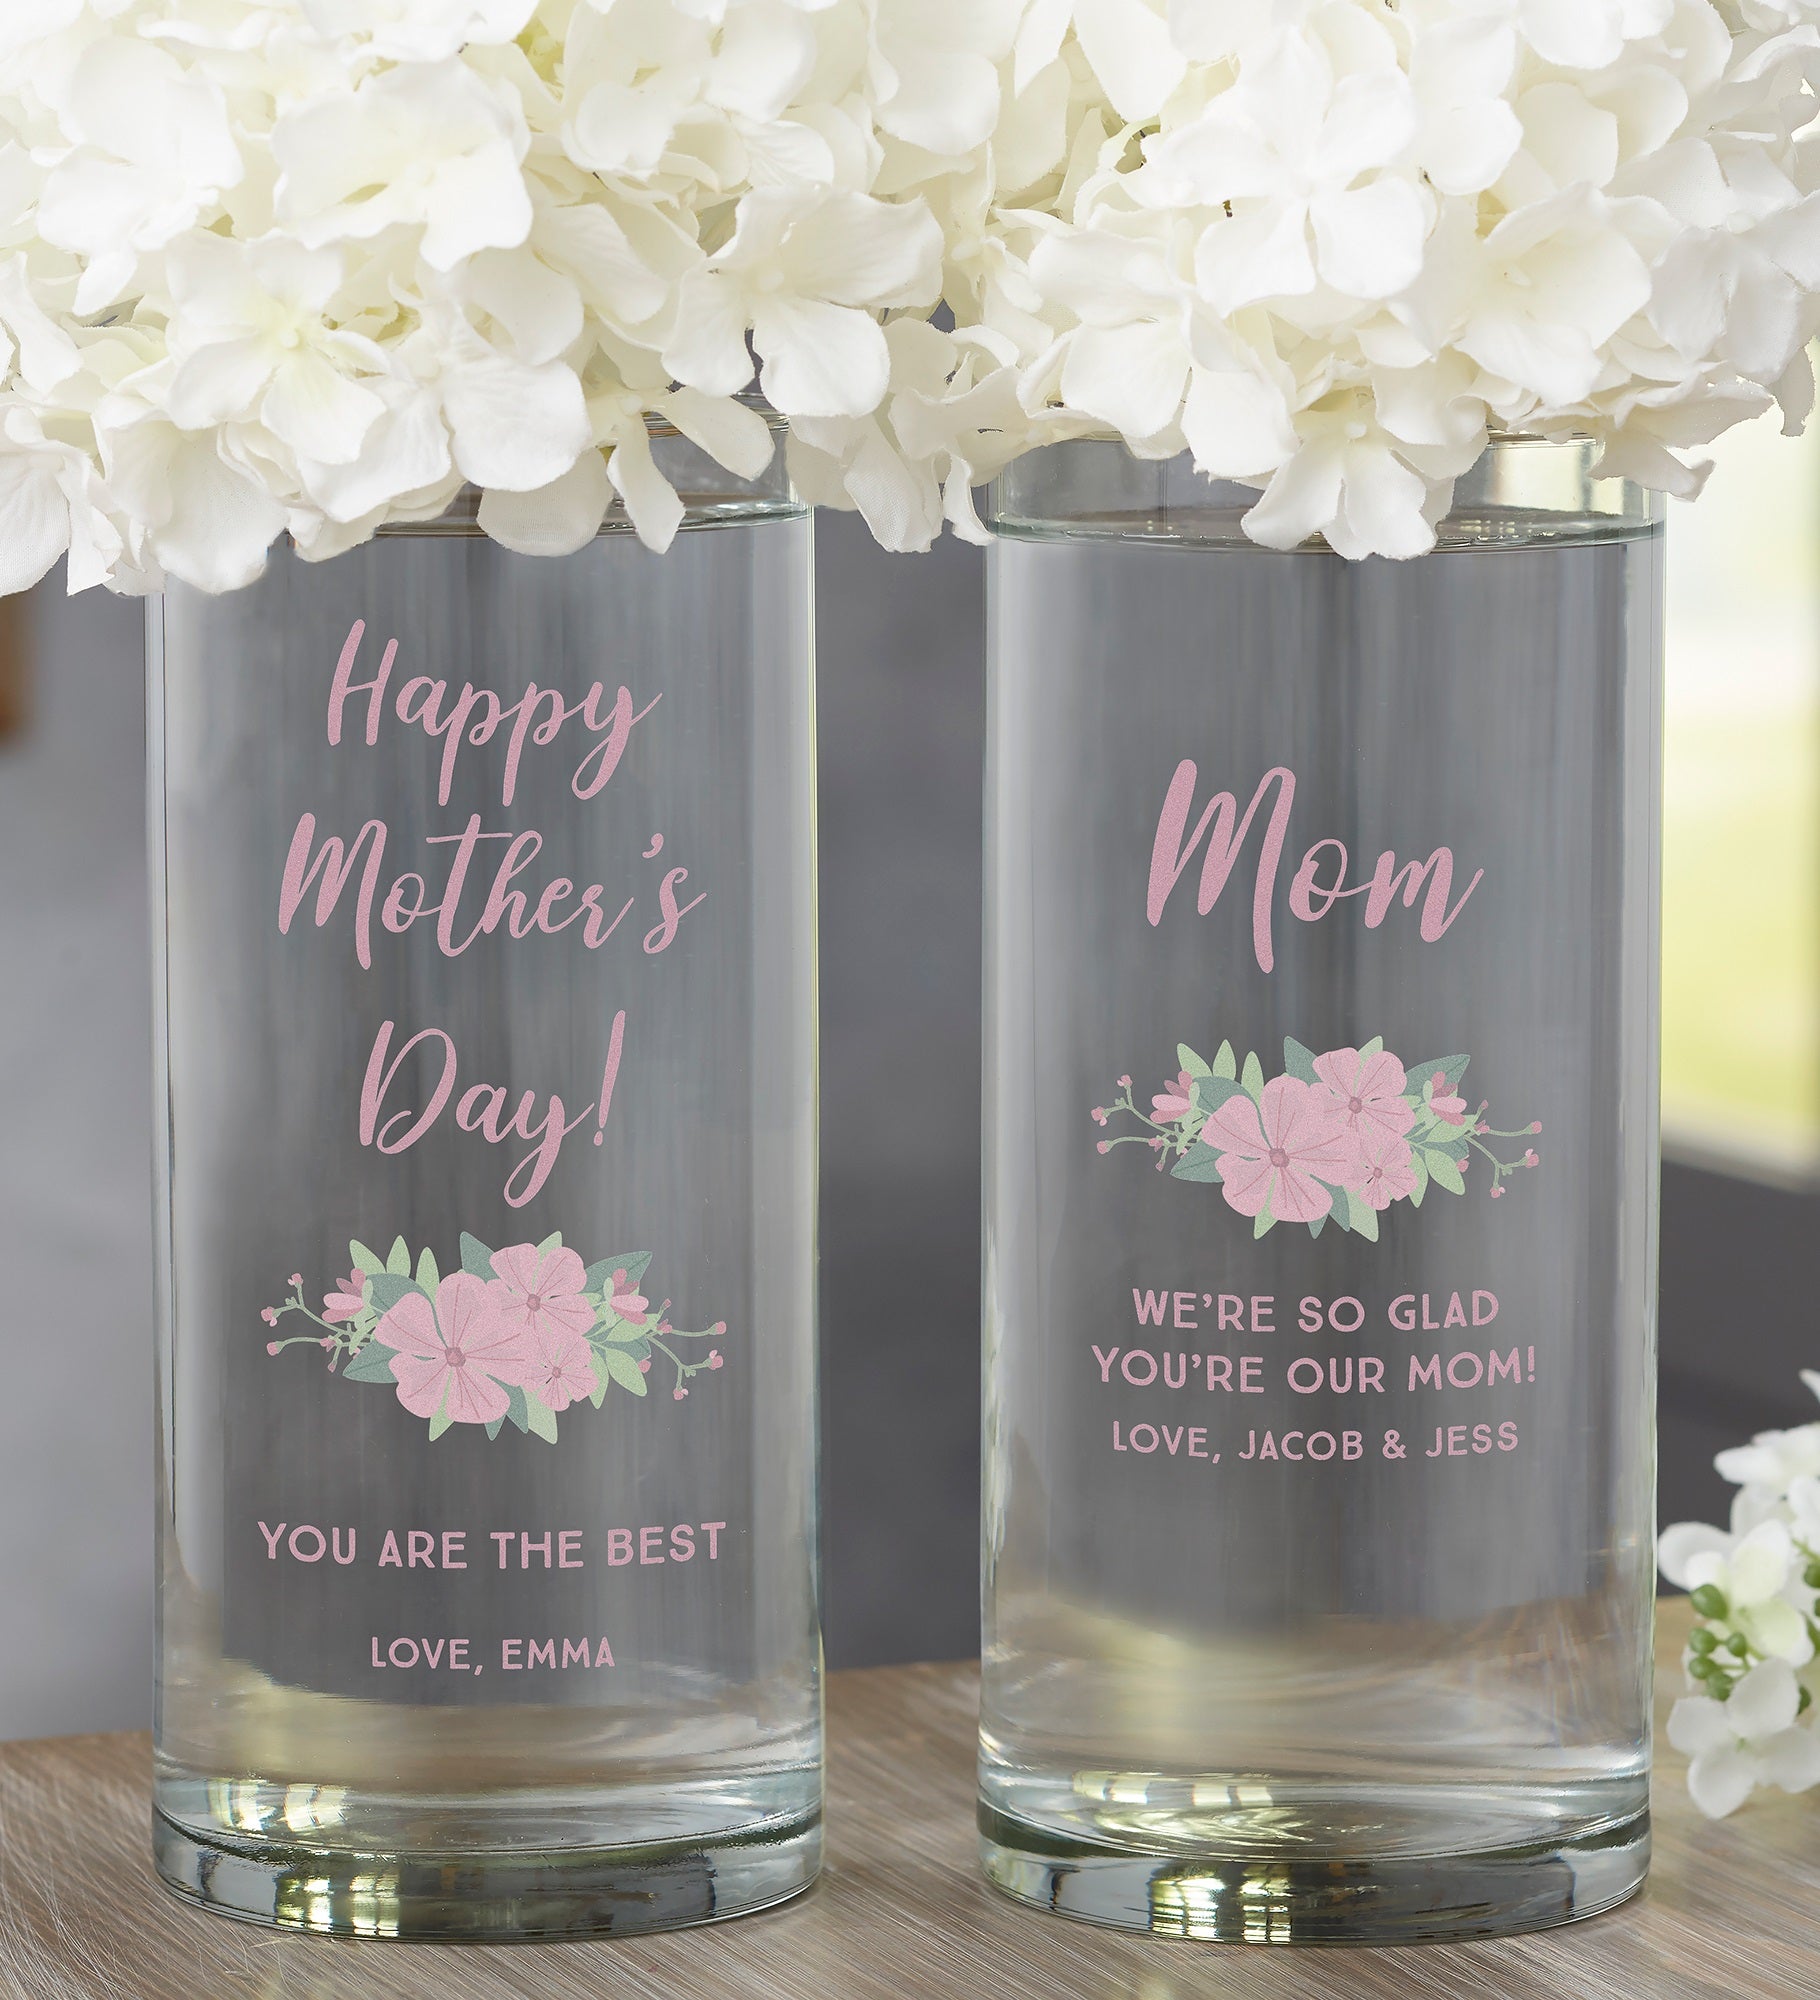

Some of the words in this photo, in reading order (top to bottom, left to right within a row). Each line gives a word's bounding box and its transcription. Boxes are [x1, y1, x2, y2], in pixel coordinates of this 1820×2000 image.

[327, 619, 663, 806] Happy
[1146, 759, 1484, 973] Mom
[359, 1011, 625, 1208] Day!
[1297, 1296, 1365, 1333] SO
[1388, 1289, 1500, 1331] GLAD
[1287, 1357, 1385, 1394] OUR
[1408, 1346, 1535, 1391] MOM!
[1113, 1420, 1220, 1464] LOVE,
[1239, 1430, 1363, 1461] JACOB
[1382, 1429, 1406, 1460] &
[1425, 1421, 1518, 1457] JESS
[257, 1521, 356, 1565] YOU
[378, 1530, 467, 1569] ARE
[490, 1530, 584, 1569] THE
[607, 1521, 726, 1567] BEST
[371, 1637, 484, 1676] LOVE,
[502, 1637, 615, 1670] EMMA
